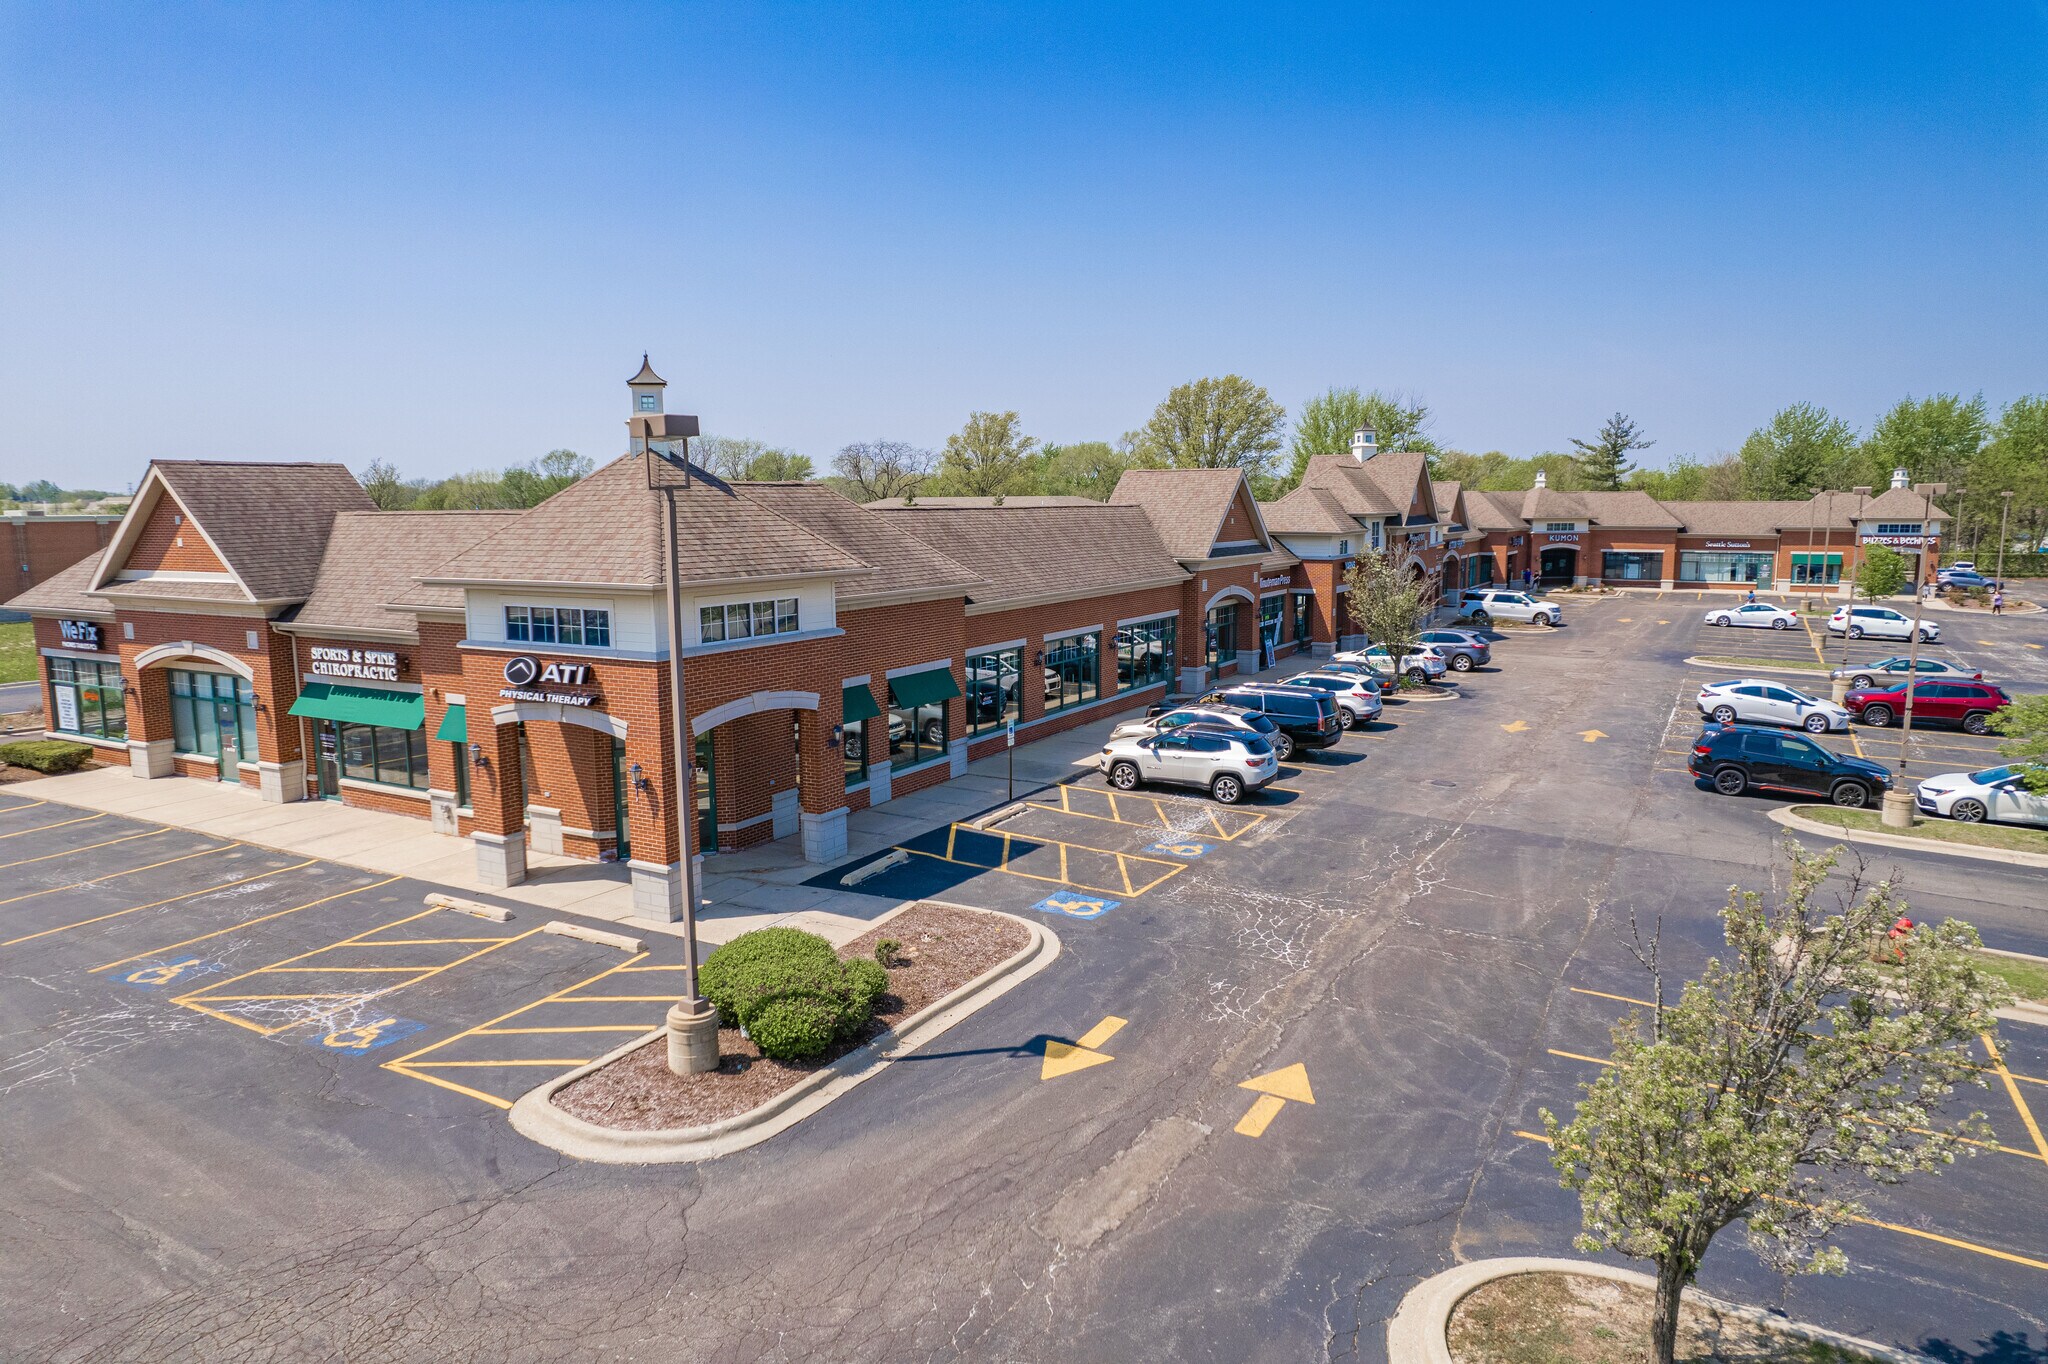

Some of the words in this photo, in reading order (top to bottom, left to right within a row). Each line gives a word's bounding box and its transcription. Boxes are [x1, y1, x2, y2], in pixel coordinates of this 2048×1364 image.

[1549, 534, 1579, 542] KUMON
[310, 647, 349, 661] SPORTS
[352, 650, 362, 663] &
[365, 651, 397, 666] SPINE
[312, 661, 398, 681] CHIROPRACTIC
[539, 663, 585, 685] ATI
[499, 689, 545, 702] PHYSICAL
[546, 693, 591, 706] THERAPY
